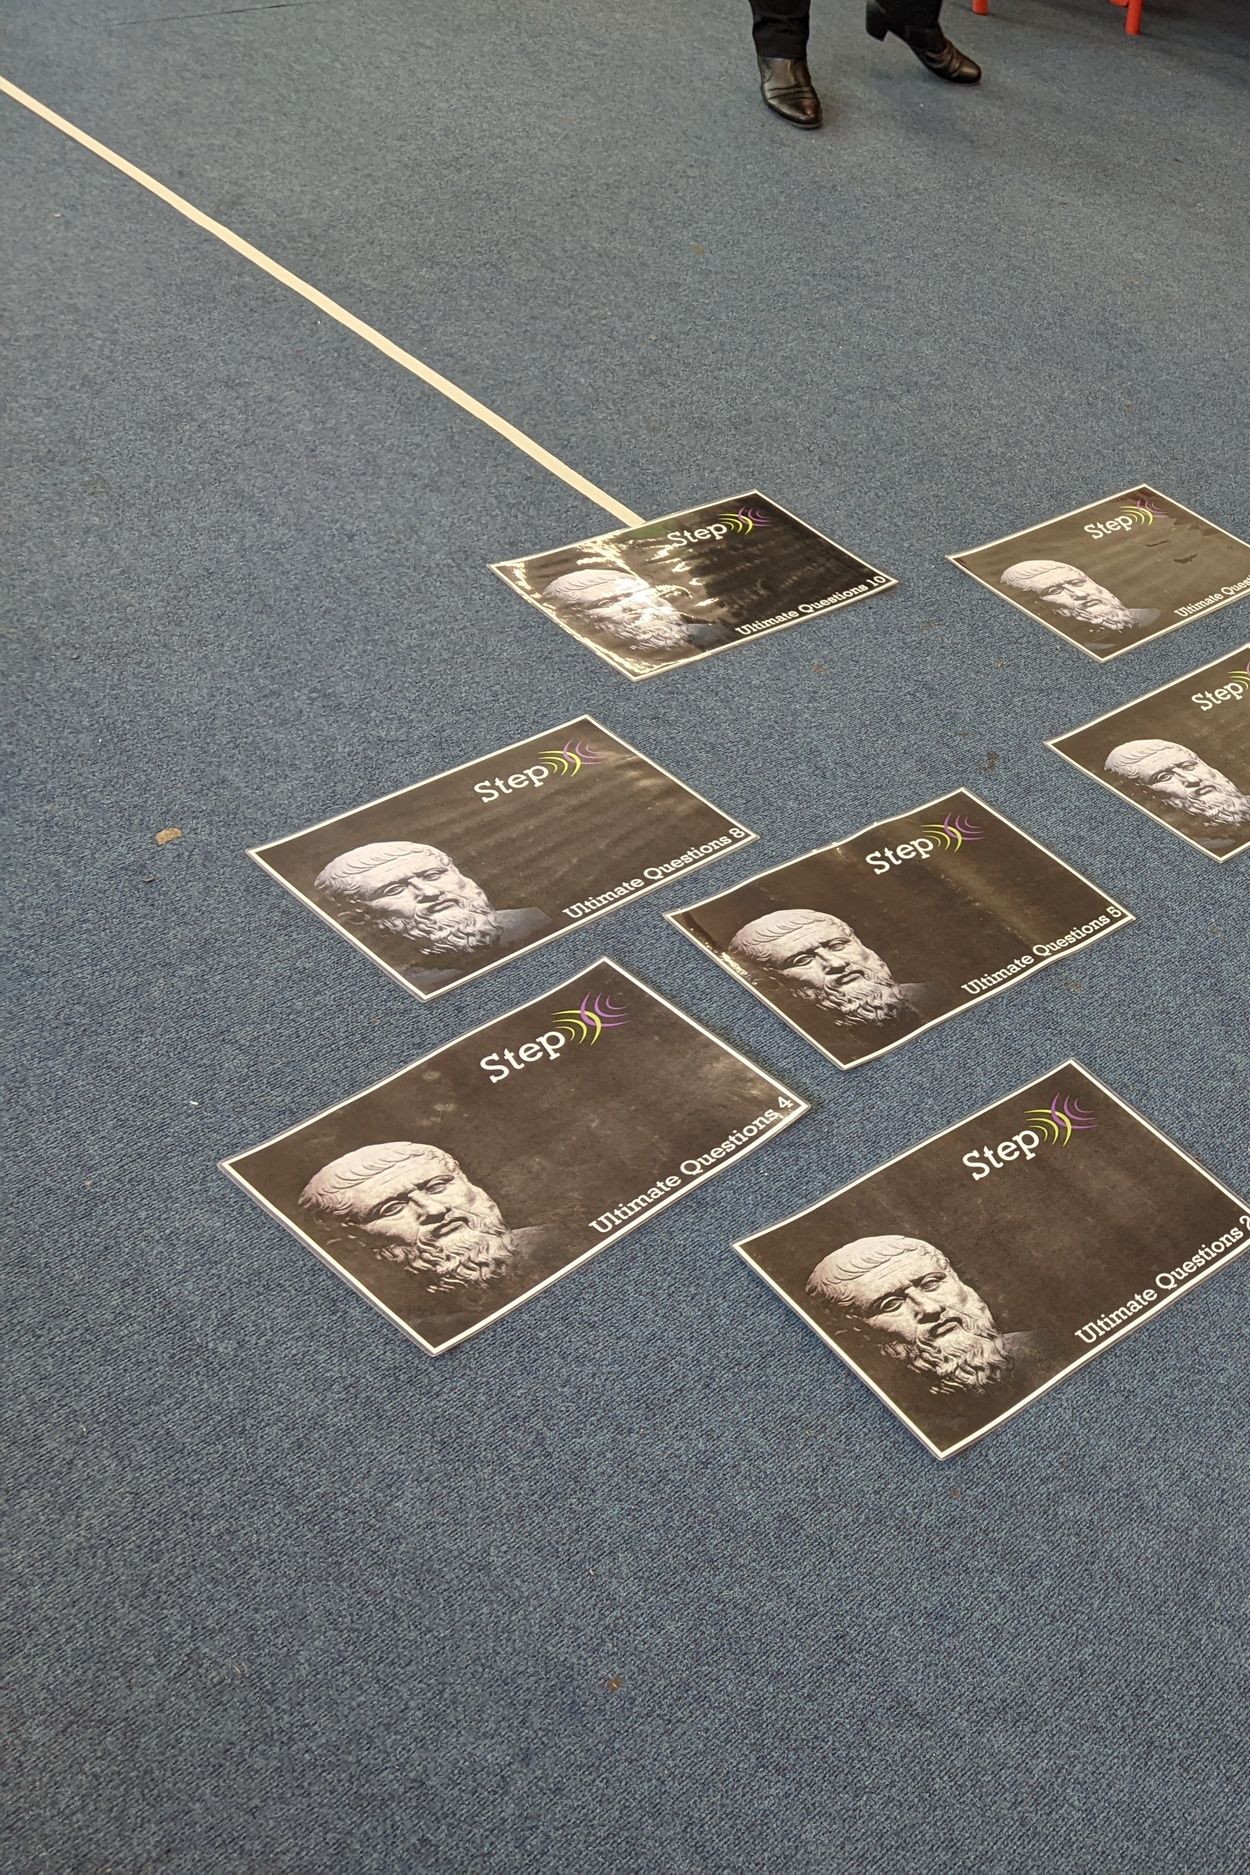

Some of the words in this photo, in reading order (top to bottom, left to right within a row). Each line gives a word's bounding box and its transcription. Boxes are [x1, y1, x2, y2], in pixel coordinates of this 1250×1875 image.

[667, 522, 728, 547] Step
[1084, 513, 1134, 540] Step
[735, 609, 800, 636] Ultimate
[799, 583, 868, 614] Questions
[866, 575, 886, 591] 10
[1174, 592, 1224, 618] Ultimate
[1191, 681, 1244, 711] Step
[473, 763, 550, 803] Step
[562, 876, 645, 920] Ultimate
[644, 832, 733, 879] Questions
[731, 827, 745, 840] 8
[866, 836, 934, 875] Step
[962, 955, 1035, 996] Ultimate
[1032, 913, 1111, 957] Questions
[1108, 907, 1122, 920] 5
[479, 1027, 567, 1085] Step
[589, 1171, 682, 1236] Ultimate
[679, 1107, 781, 1176] Questions
[776, 1096, 794, 1112] 4
[961, 1129, 1040, 1181] Step
[1075, 1287, 1159, 1345] Ultimate
[1155, 1225, 1245, 1291] Questions
